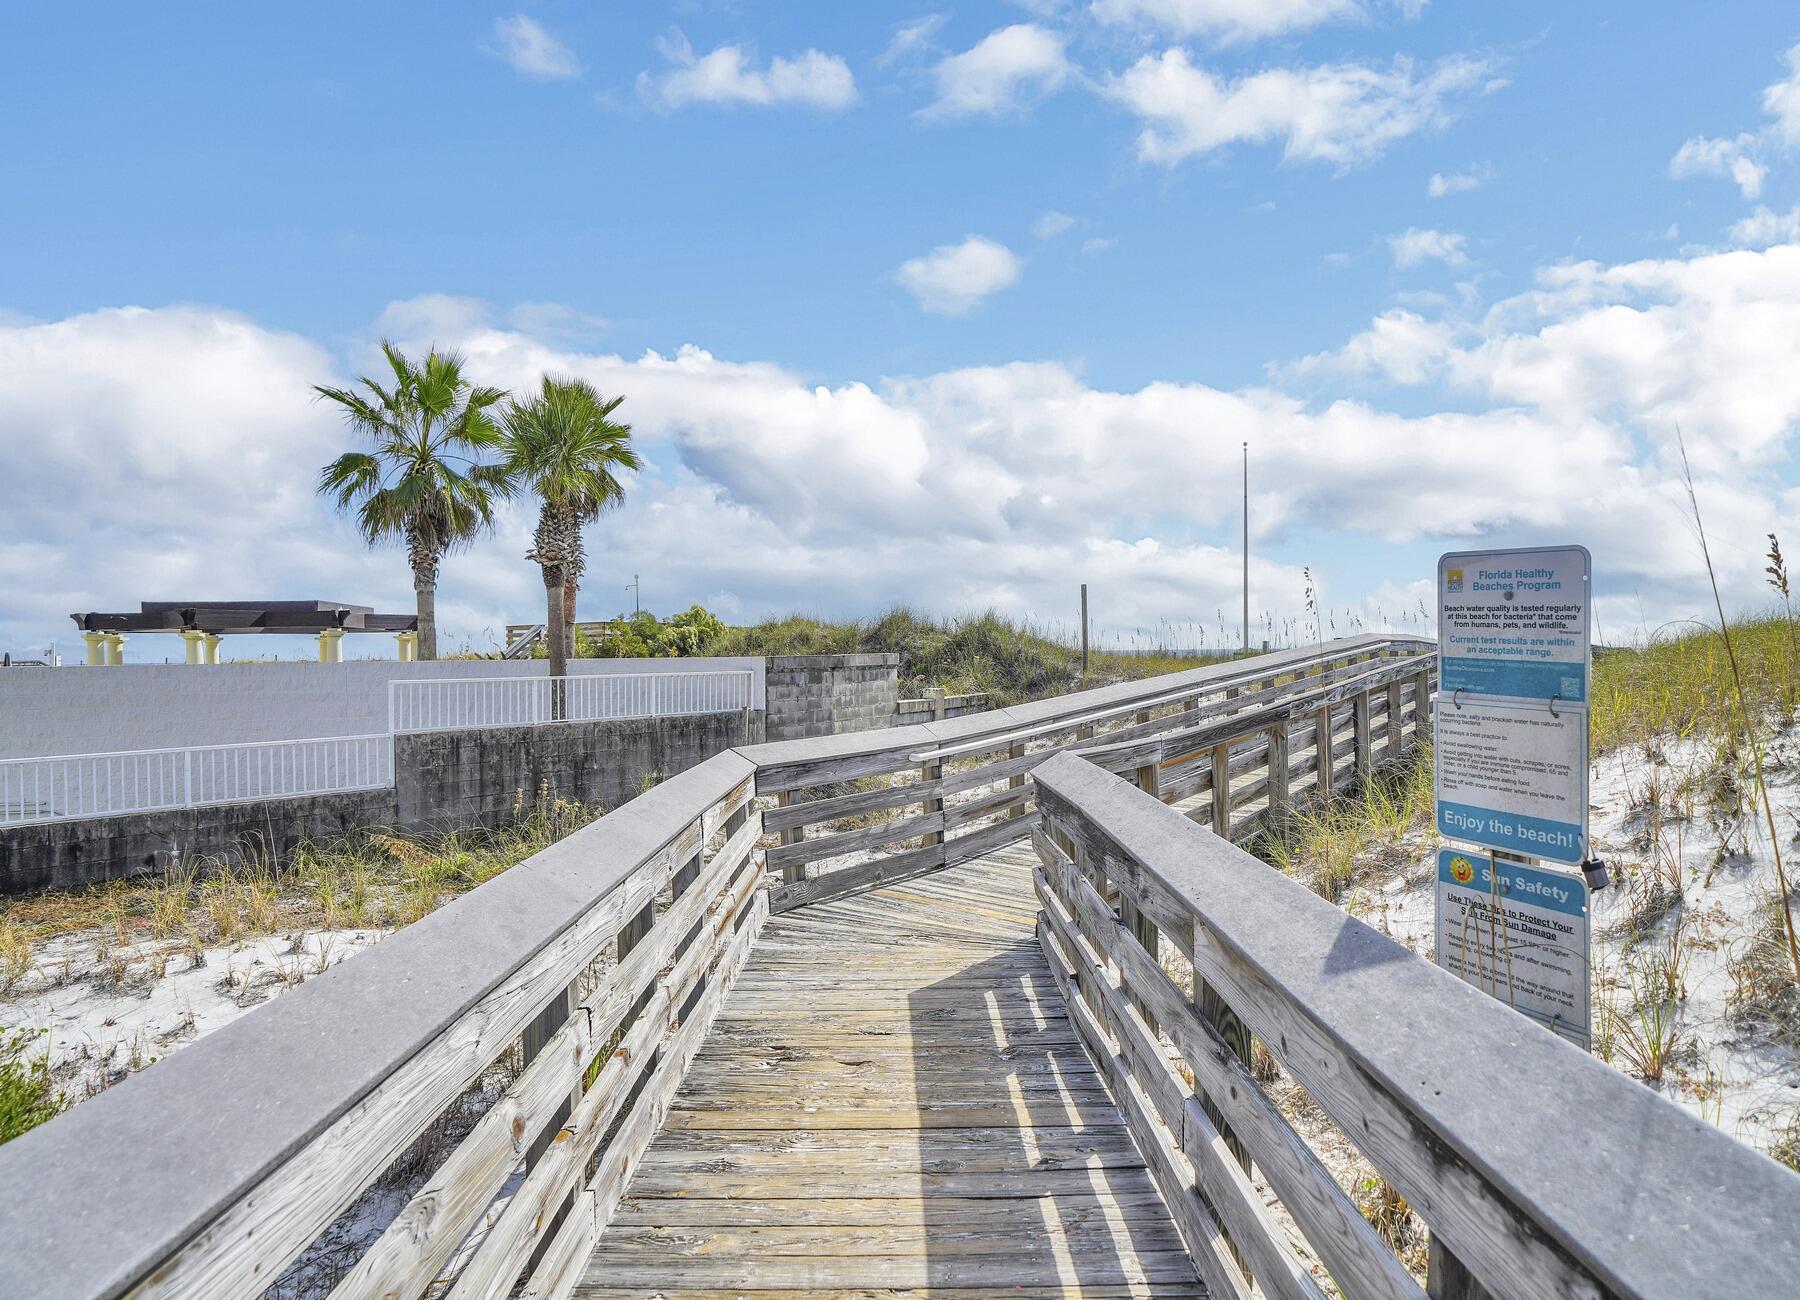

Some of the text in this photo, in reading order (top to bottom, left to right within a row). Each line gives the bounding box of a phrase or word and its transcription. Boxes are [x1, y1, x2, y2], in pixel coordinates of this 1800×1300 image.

[1479, 569, 1554, 580] Florida Healthy
[1473, 582, 1513, 591] Beaches
[1517, 581, 1561, 591] Program
[1546, 604, 1581, 613] regularly
[1450, 635, 1479, 644] Current
[1478, 647, 1523, 656] acceptable
[1445, 810, 1573, 848] Enjoy the beach!
[1516, 877, 1569, 903] Safety
[1447, 892, 1462, 903] Use
[1508, 909, 1517, 918] to
[1519, 912, 1550, 927] Protect
[1552, 920, 1574, 932] Your
[1522, 923, 1557, 940] Damage
[1514, 953, 1525, 961] and
[1516, 976, 1525, 984] the
[1526, 980, 1538, 989] way
[1540, 984, 1561, 995] around
[1562, 991, 1574, 1000] that
